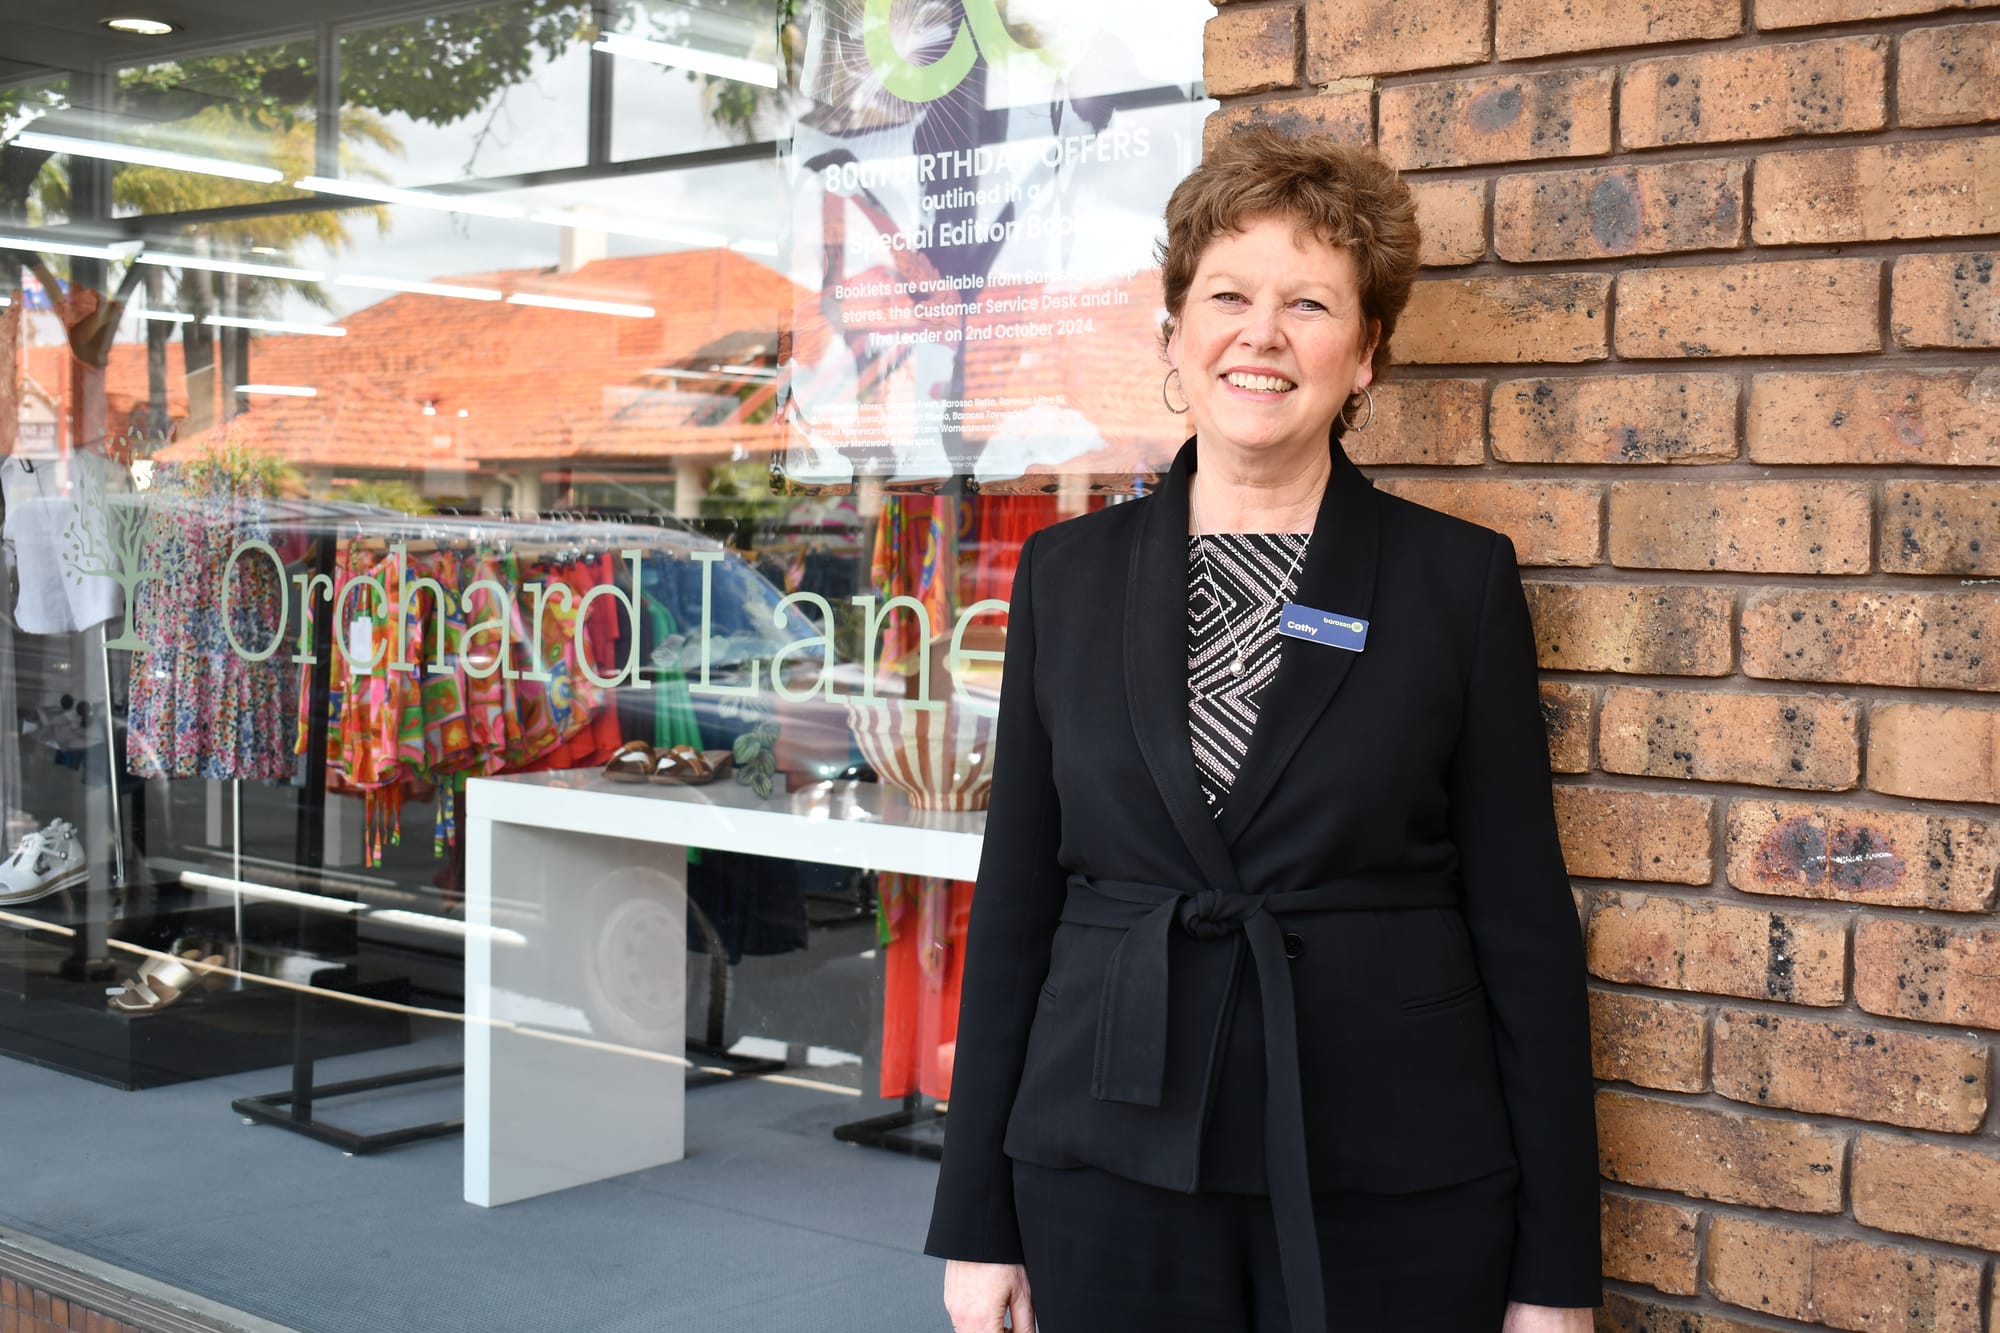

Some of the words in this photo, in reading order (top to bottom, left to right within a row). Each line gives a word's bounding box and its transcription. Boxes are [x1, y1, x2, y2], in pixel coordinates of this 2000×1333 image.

[894, 145, 1028, 184] BIRTHDA
[1041, 128, 1151, 168] OFFERS
[921, 184, 1001, 212] outlined
[1004, 182, 1023, 203] in
[1027, 183, 1040, 199] a
[939, 216, 1021, 248] Edition
[835, 282, 891, 300] Booklets
[893, 279, 916, 295] are
[919, 272, 984, 294] available
[987, 270, 1021, 288] from
[842, 303, 886, 324] stores,
[888, 303, 911, 320] the
[914, 299, 983, 319] Customer
[985, 296, 1038, 313] Service
[1041, 293, 1077, 310] Desk
[1080, 289, 1110, 308] and
[1114, 288, 1129, 305] in
[869, 331, 894, 347] The
[896, 328, 942, 345] Leader
[945, 329, 962, 343] on
[965, 324, 992, 341] 2nd
[995, 320, 1054, 338] October
[1057, 318, 1097, 336] 2024.
[221, 540, 652, 690] Orchard
[688, 550, 1012, 718] Lane
[1287, 620, 1318, 636] Cathy
